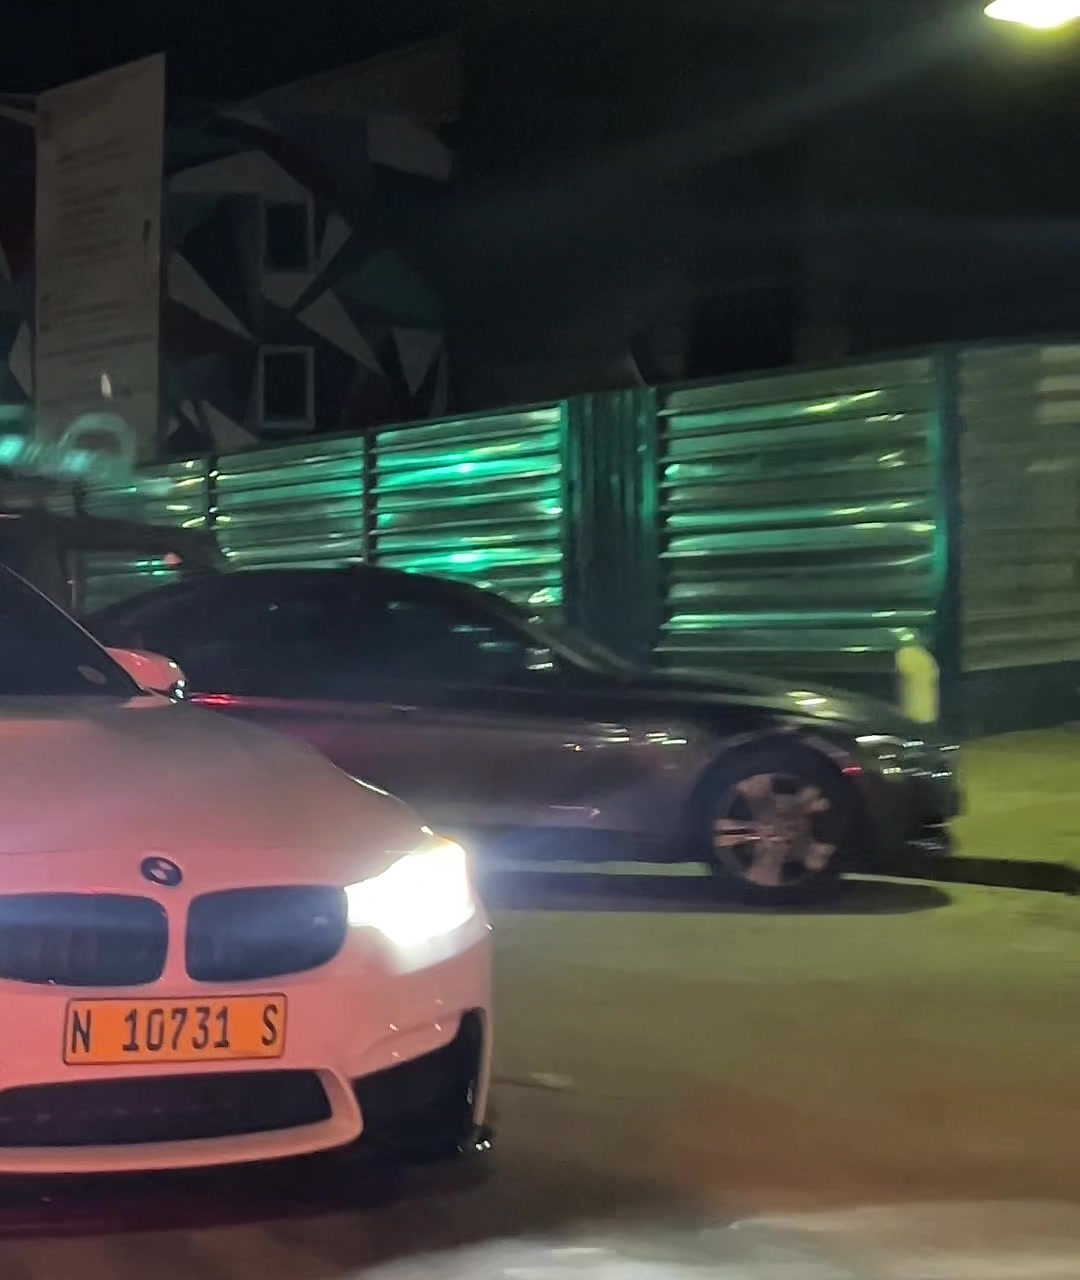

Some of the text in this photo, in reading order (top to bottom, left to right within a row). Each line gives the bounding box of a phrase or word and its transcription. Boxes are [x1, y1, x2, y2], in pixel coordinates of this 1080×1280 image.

[71, 1004, 278, 1053] N 10731 S
